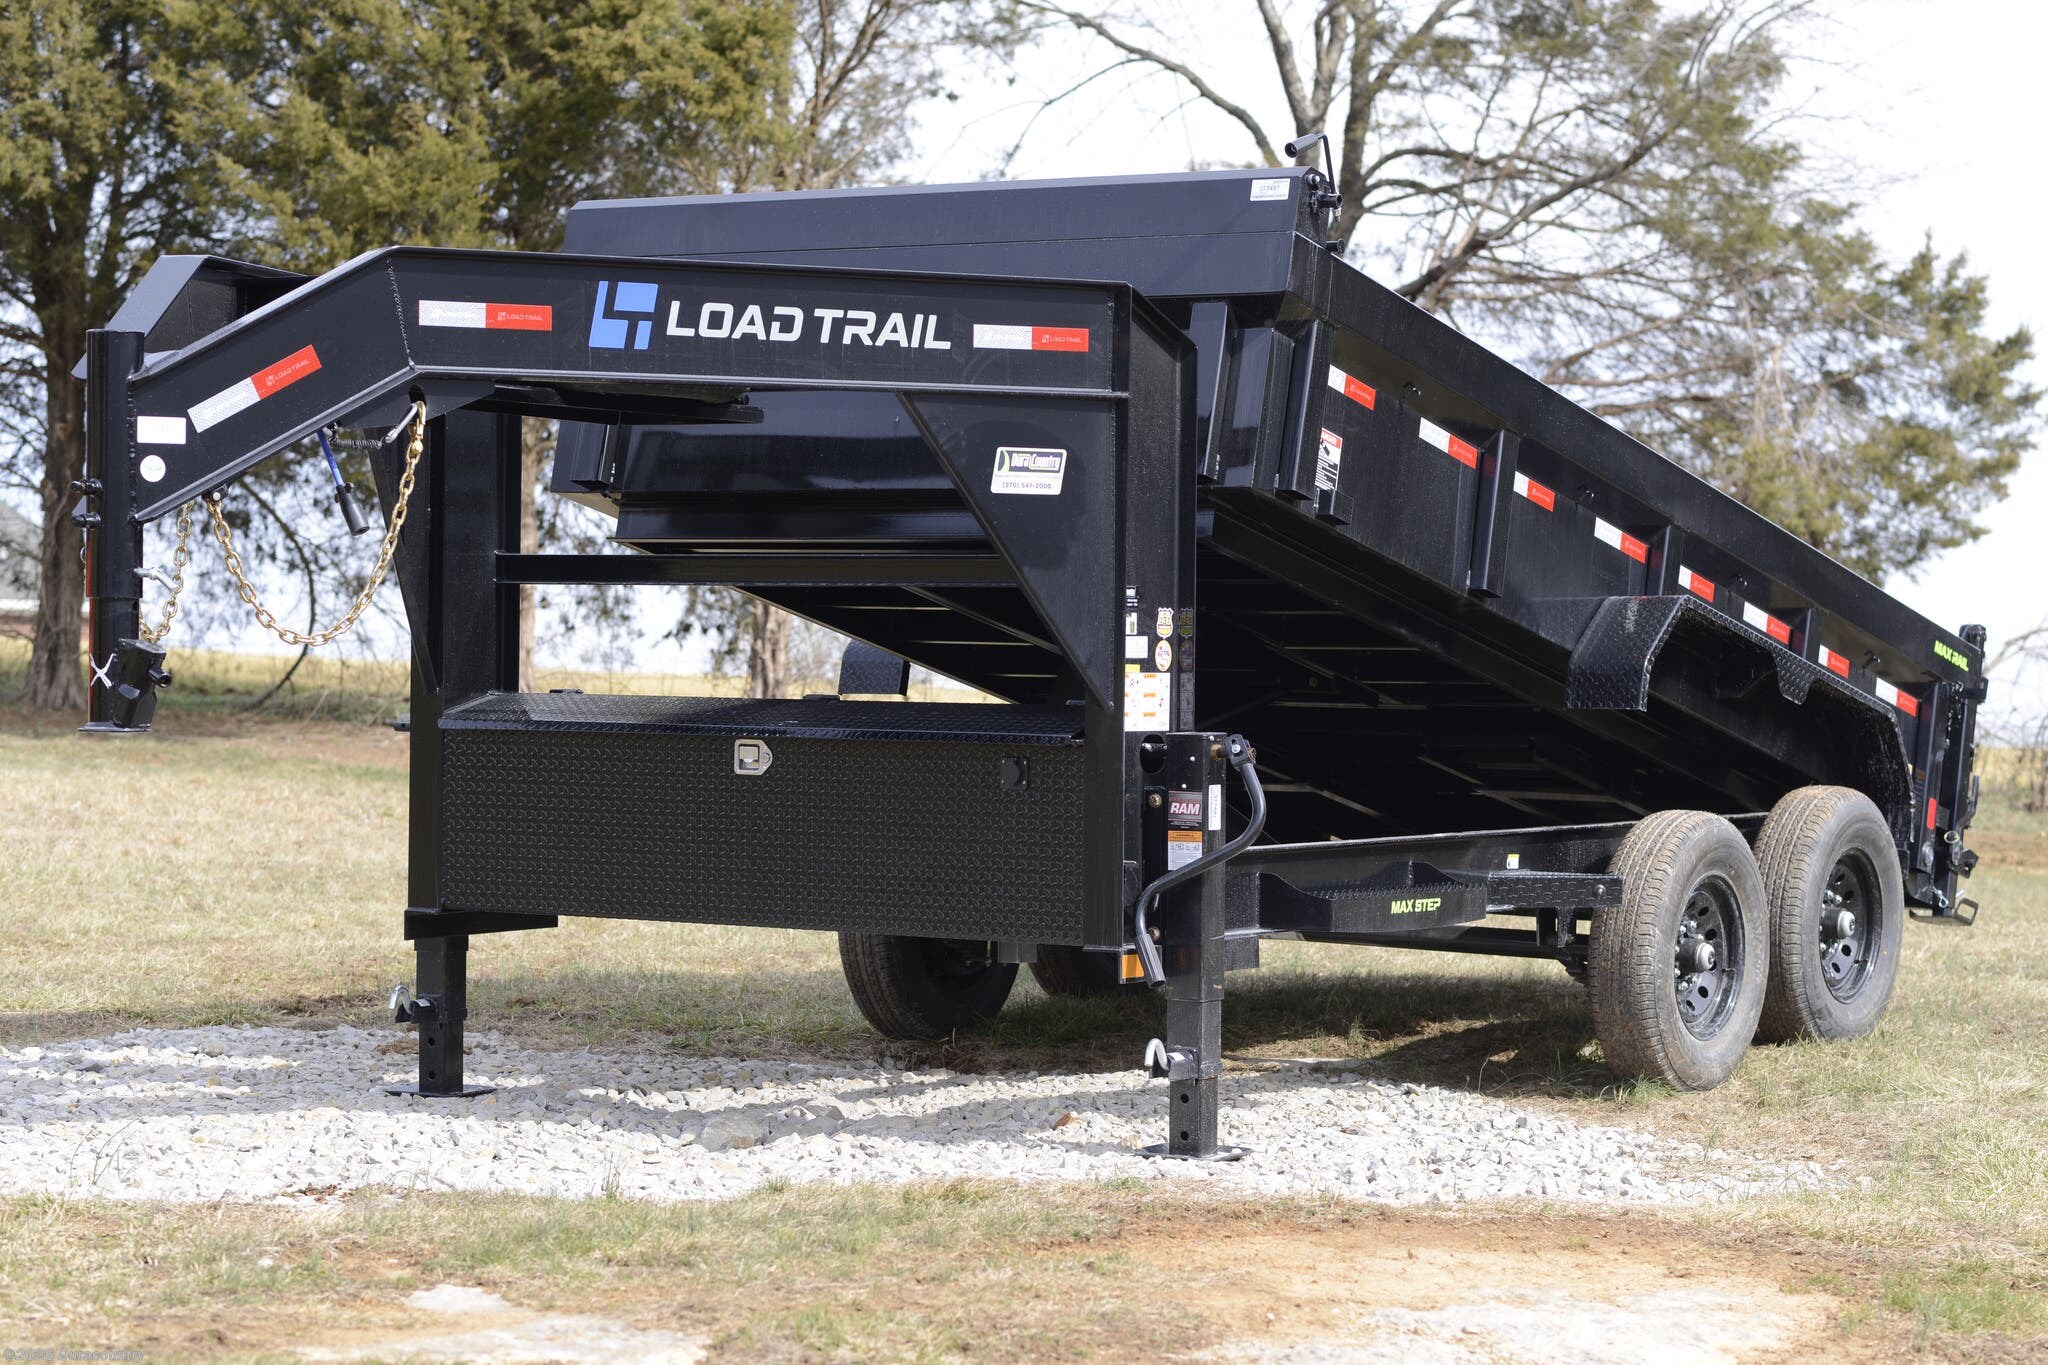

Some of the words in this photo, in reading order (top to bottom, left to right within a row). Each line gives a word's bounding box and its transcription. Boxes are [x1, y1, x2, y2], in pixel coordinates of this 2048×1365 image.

[666, 300, 804, 342] LOAD
[813, 308, 952, 350] TRAIL
[1934, 640, 1953, 661] MAX
[1951, 650, 1969, 672] RAIL
[1170, 802, 1200, 815] RAM
[1391, 899, 1414, 914] MAX
[1414, 897, 1441, 912] STEP
